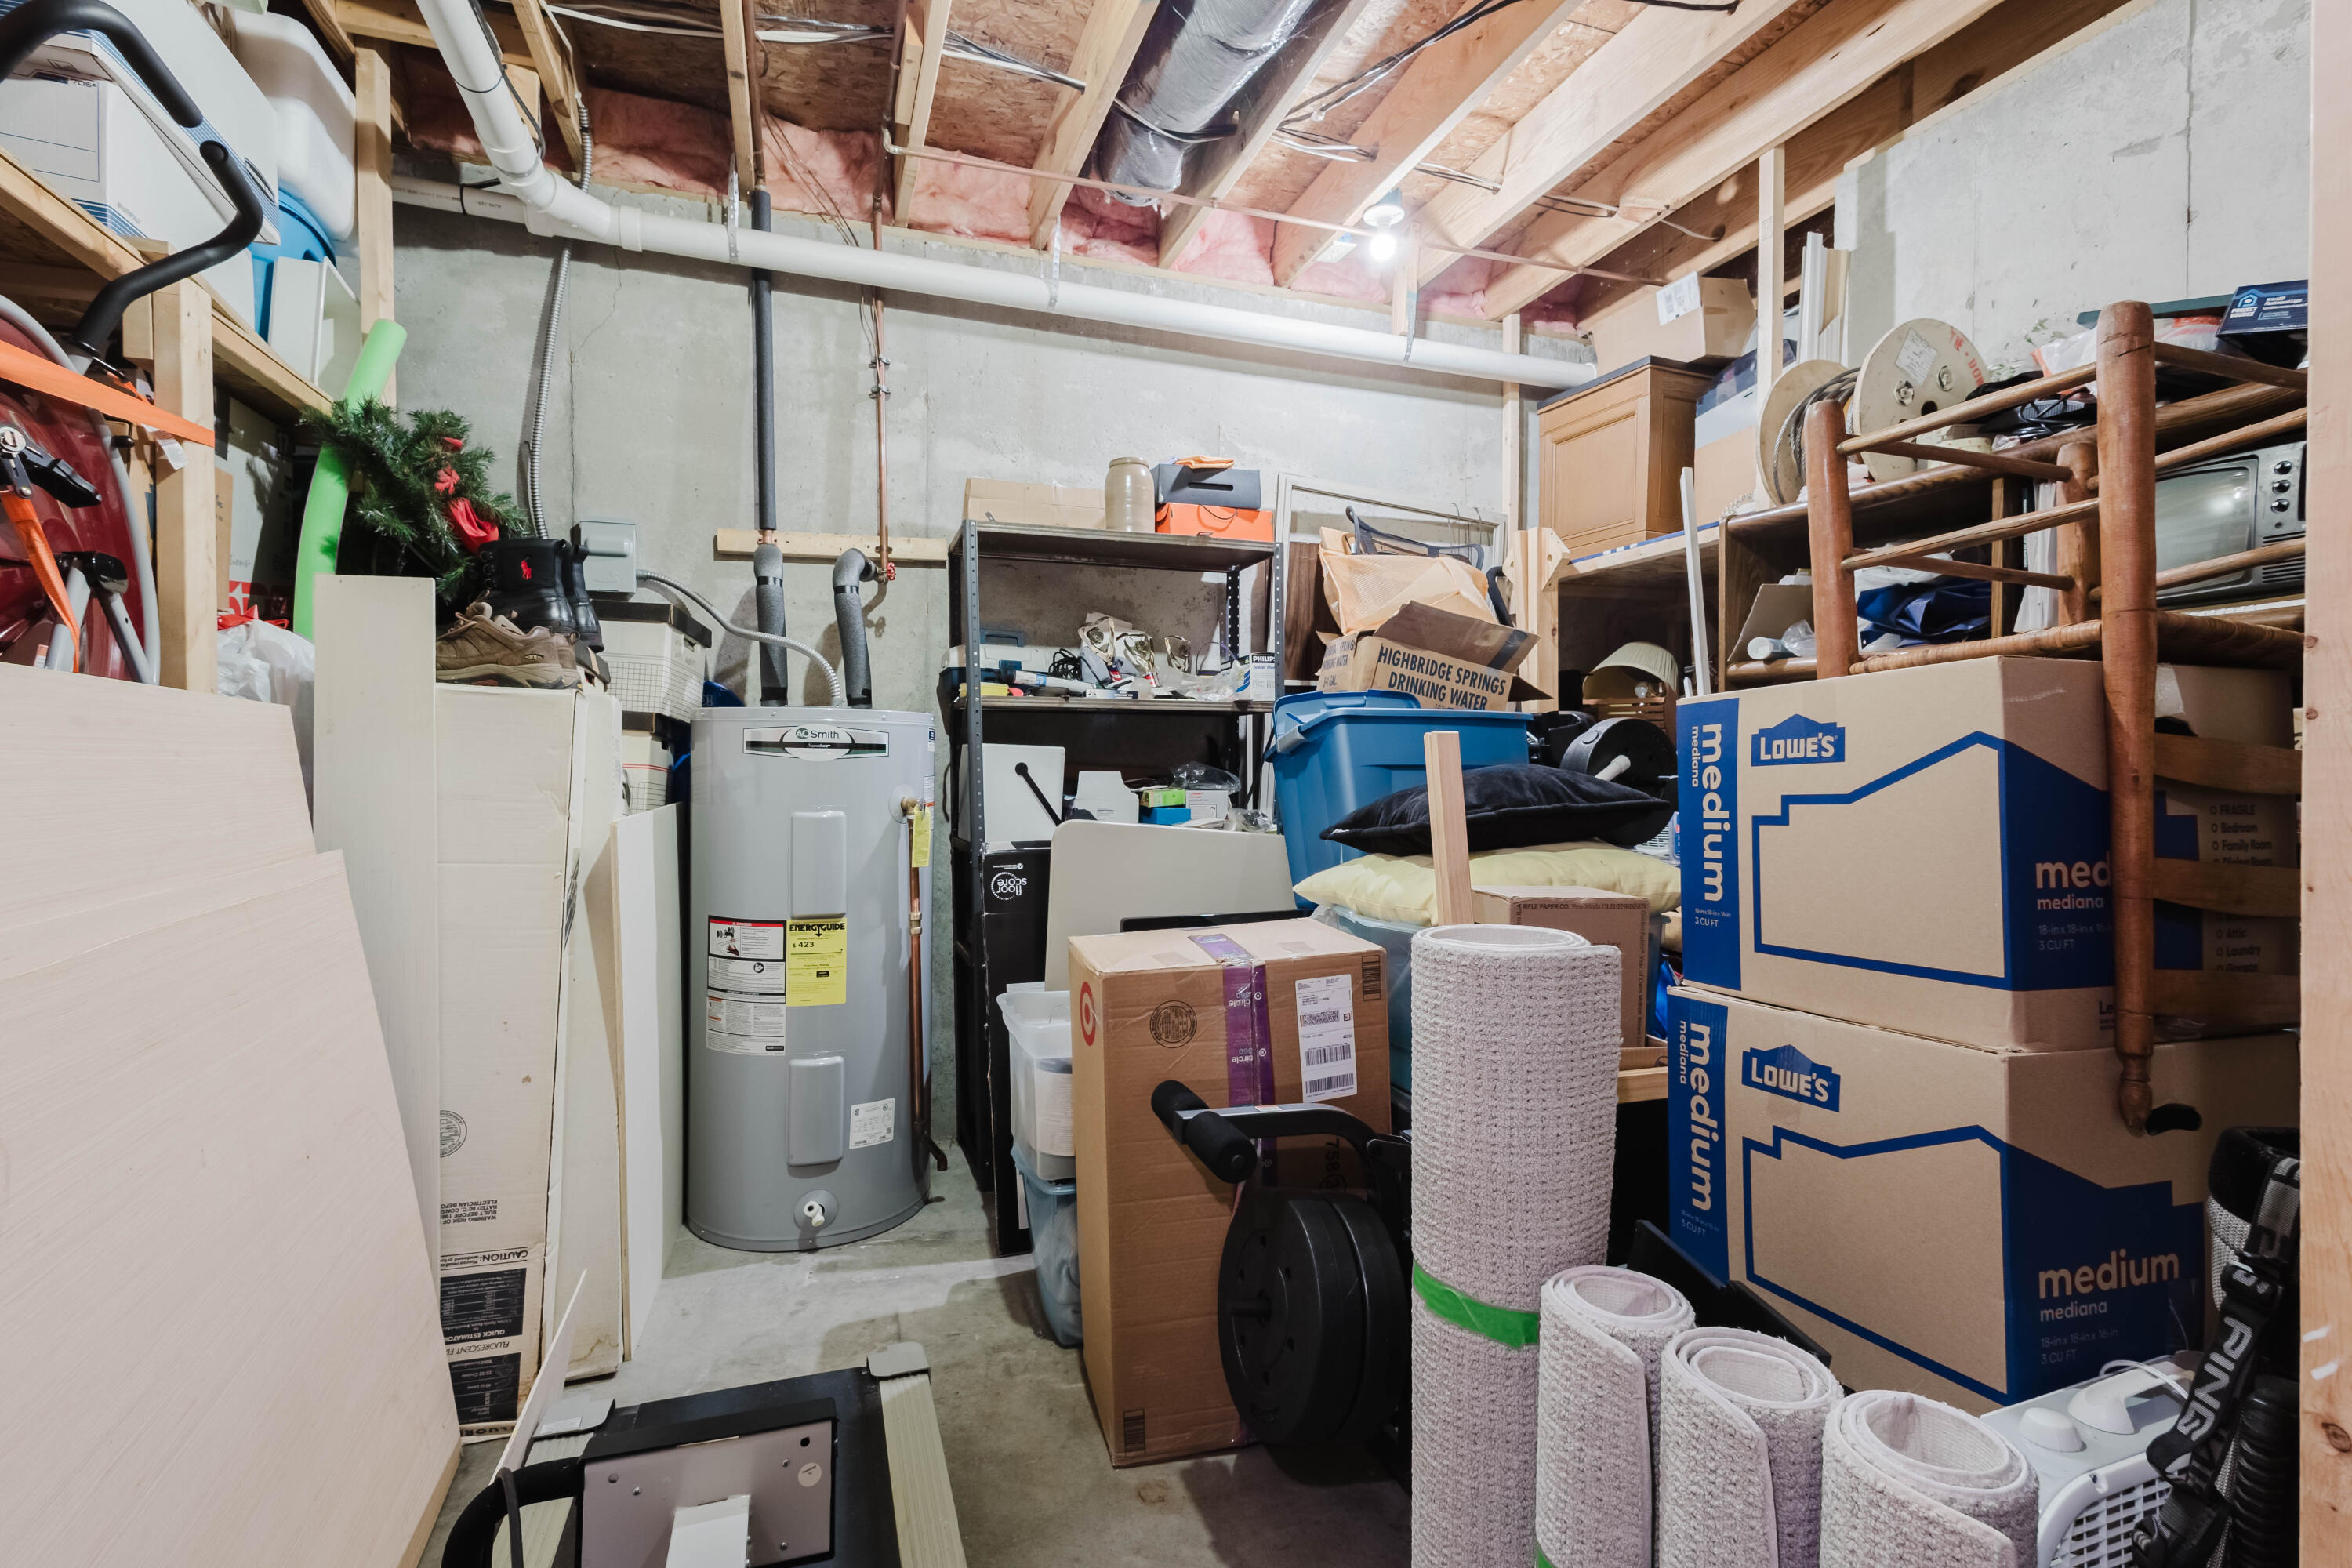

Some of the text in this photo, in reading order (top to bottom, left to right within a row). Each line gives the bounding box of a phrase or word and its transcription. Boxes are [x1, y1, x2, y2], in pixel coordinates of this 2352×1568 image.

[1377, 645, 1506, 696] HIGHBRIDGE SPRINGS
[1388, 671, 1488, 710] DRINKING WATER
[811, 730, 840, 739] Smith
[1760, 732, 1835, 760] LOWE'S
[1691, 726, 1700, 787] mediana
[1702, 723, 1730, 902] medium
[2220, 804, 2256, 816] FRAGILE
[2221, 822, 2258, 833] Bedroom
[2222, 840, 2273, 852] Family Room
[996, 885, 1023, 896] floor
[2038, 894, 2104, 910] mediana
[1694, 916, 1719, 928] 3 CU FT
[2226, 928, 2247, 938] Attic
[2038, 938, 2074, 951] 3 CU FT
[2226, 946, 2261, 956] Laundry
[1679, 1020, 1689, 1084] mediana
[1751, 1057, 1829, 1102] LOWE'S
[1690, 1022, 1719, 1211] medium
[1681, 1218, 1706, 1237] 3 CU FT
[480, 1250, 528, 1262] CAUTION:
[2039, 1248, 2180, 1299] medium
[2040, 1301, 2107, 1322] mediana
[2041, 1336, 2062, 1348] 18-in
[2070, 1332, 2090, 1343] 18-in
[2098, 1328, 2118, 1339] 16-in
[456, 1341, 510, 1354] FLUORESCENT
[2041, 1349, 2077, 1364] 3 CU FT
[2176, 1316, 2252, 1442] PING
